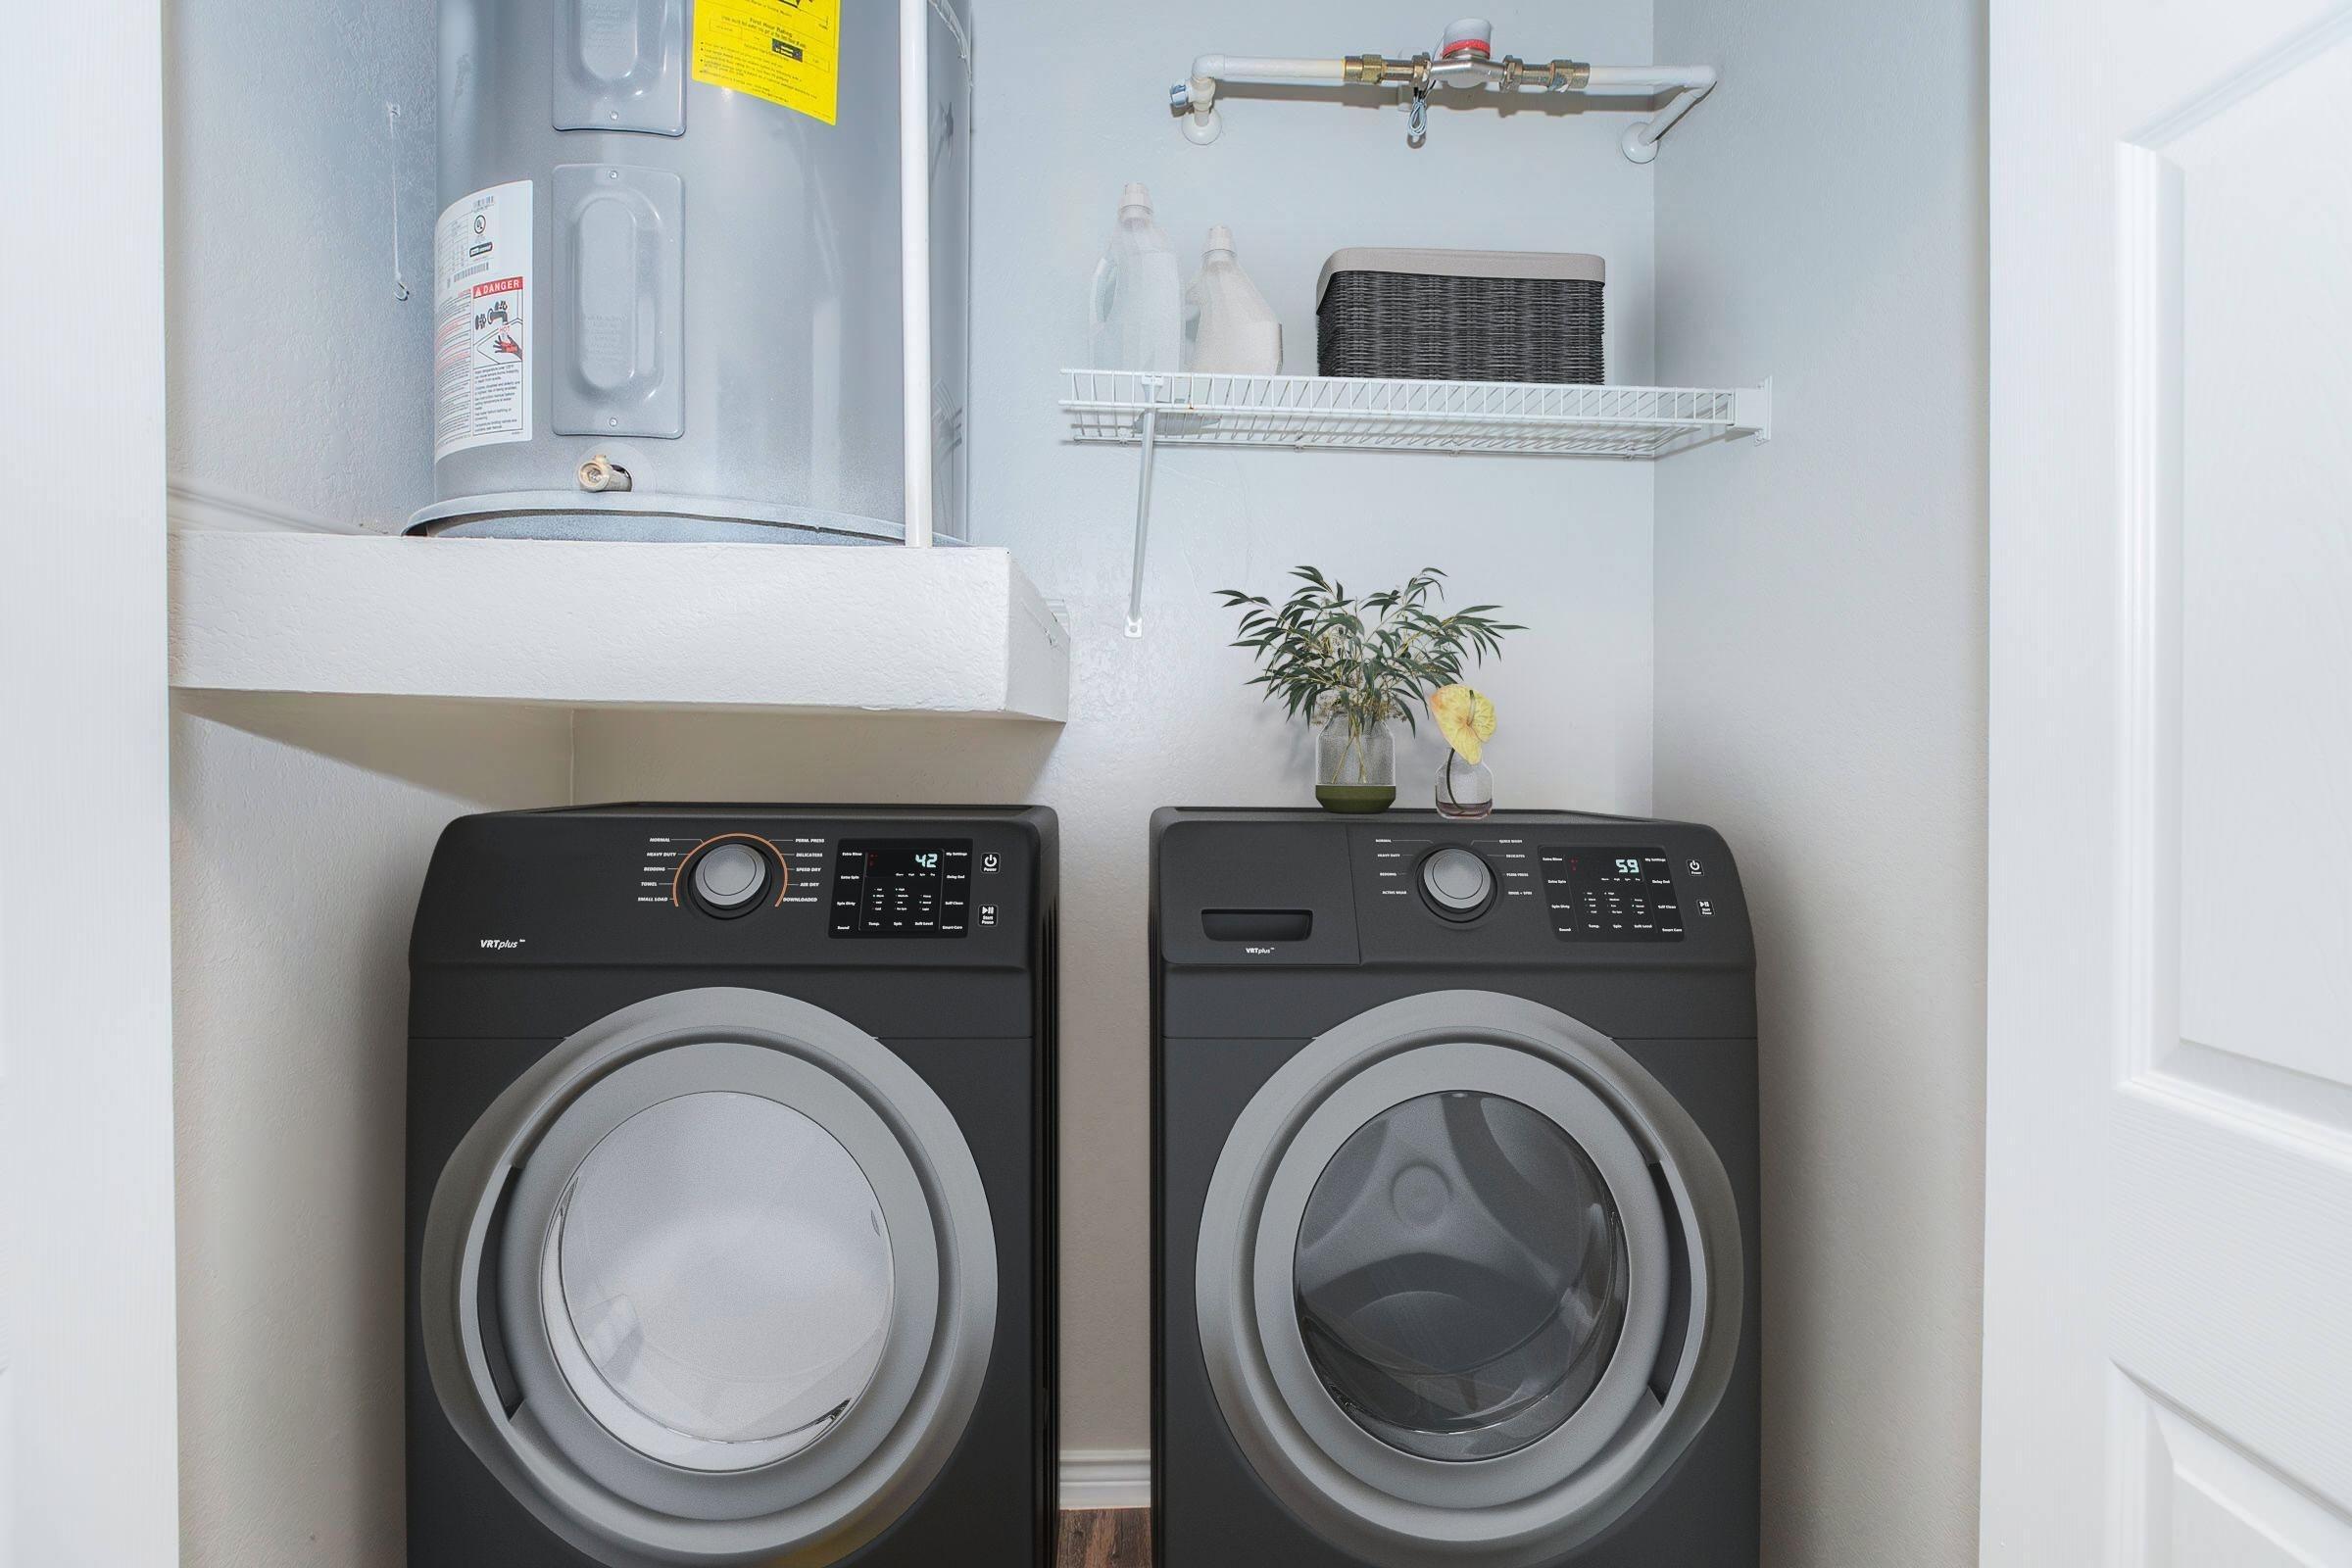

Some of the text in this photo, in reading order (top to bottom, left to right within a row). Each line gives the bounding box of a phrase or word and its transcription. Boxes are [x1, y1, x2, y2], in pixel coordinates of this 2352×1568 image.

[483, 279, 519, 294] DANGER
[914, 853, 938, 868] 42
[1615, 858, 1640, 873] 59
